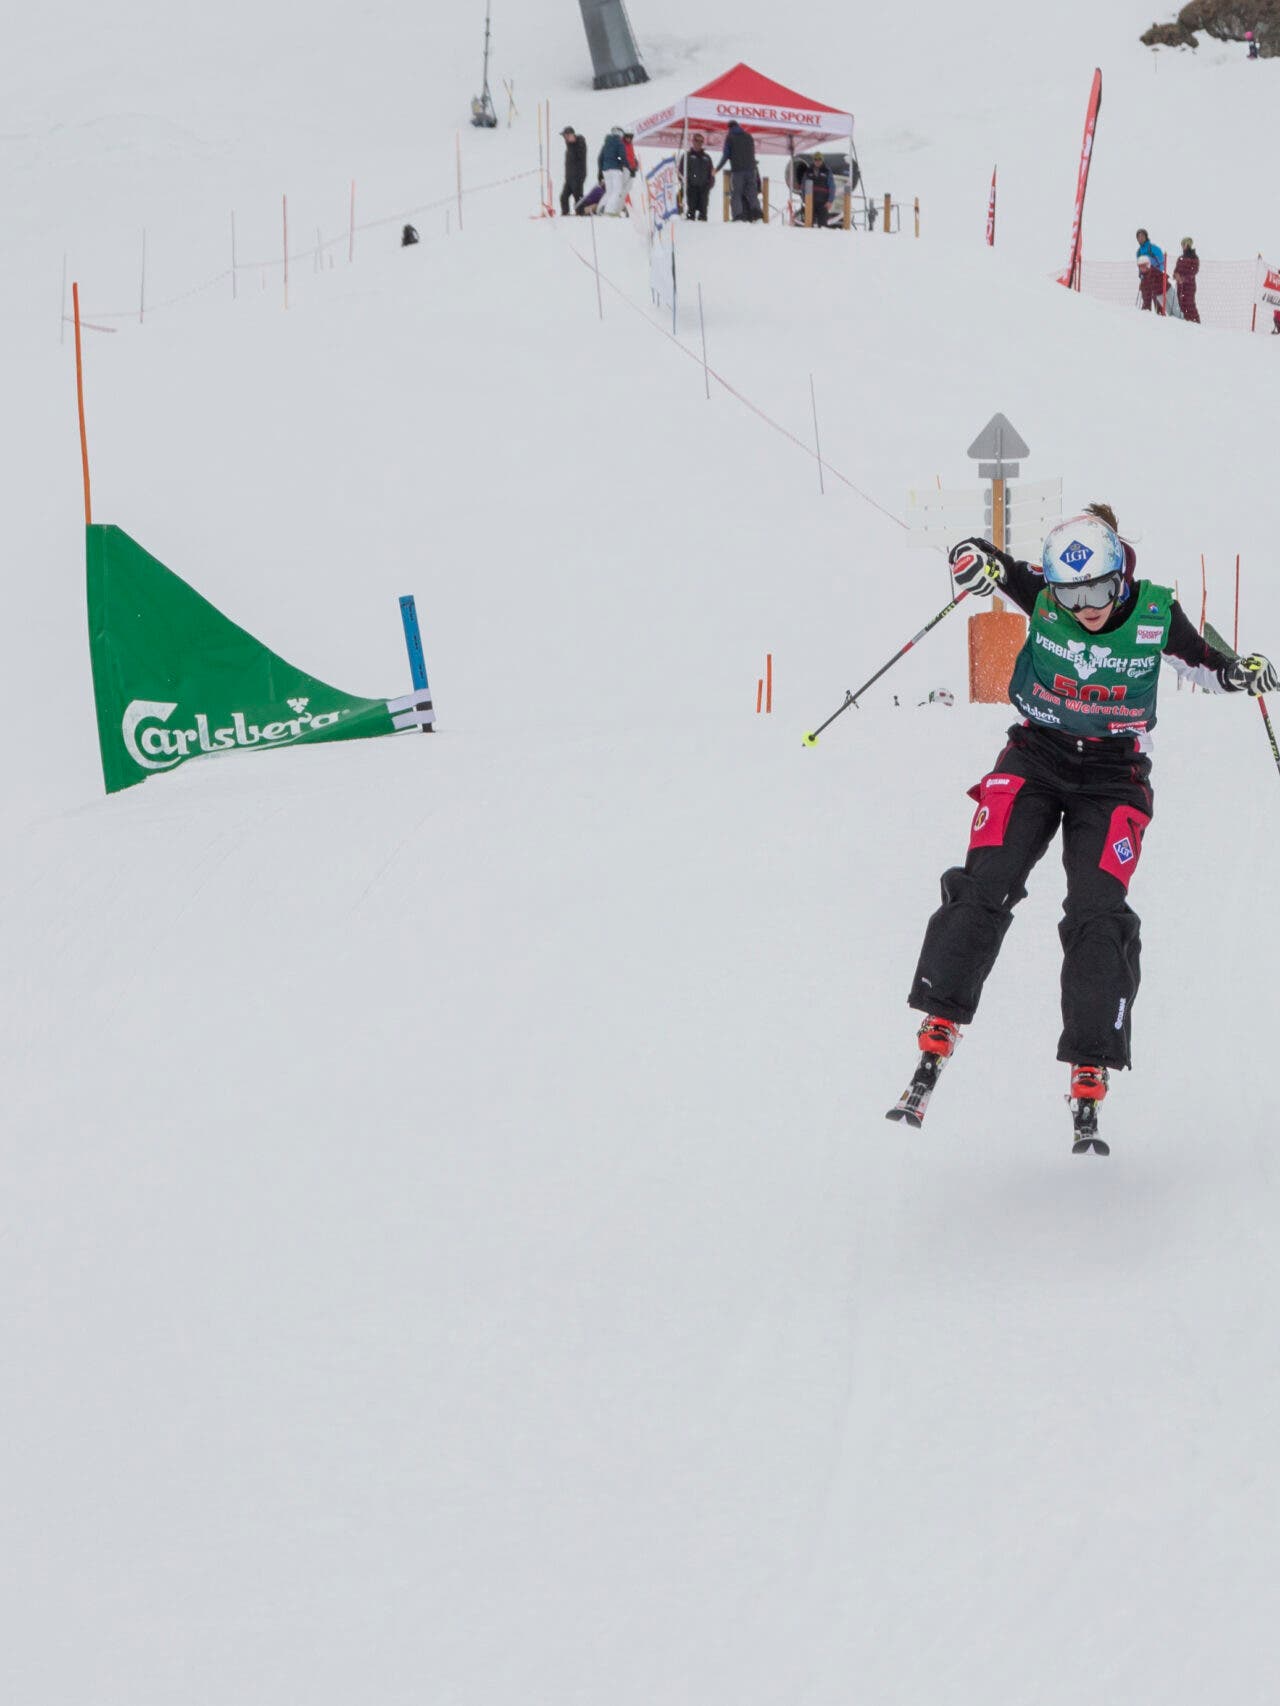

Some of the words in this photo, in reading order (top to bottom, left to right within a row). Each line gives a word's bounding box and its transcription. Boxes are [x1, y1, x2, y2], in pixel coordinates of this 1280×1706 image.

[716, 103, 777, 120] OCHSNER
[780, 111, 822, 126] SPORT
[1065, 549, 1089, 563] LGT
[1036, 631, 1084, 667] VERBIER
[1091, 655, 1128, 669] HIGH
[1128, 655, 1156, 668] FIVE
[1053, 673, 1128, 702] 501
[1065, 698, 1146, 718] Weirather
[1117, 844, 1131, 857] LGT
